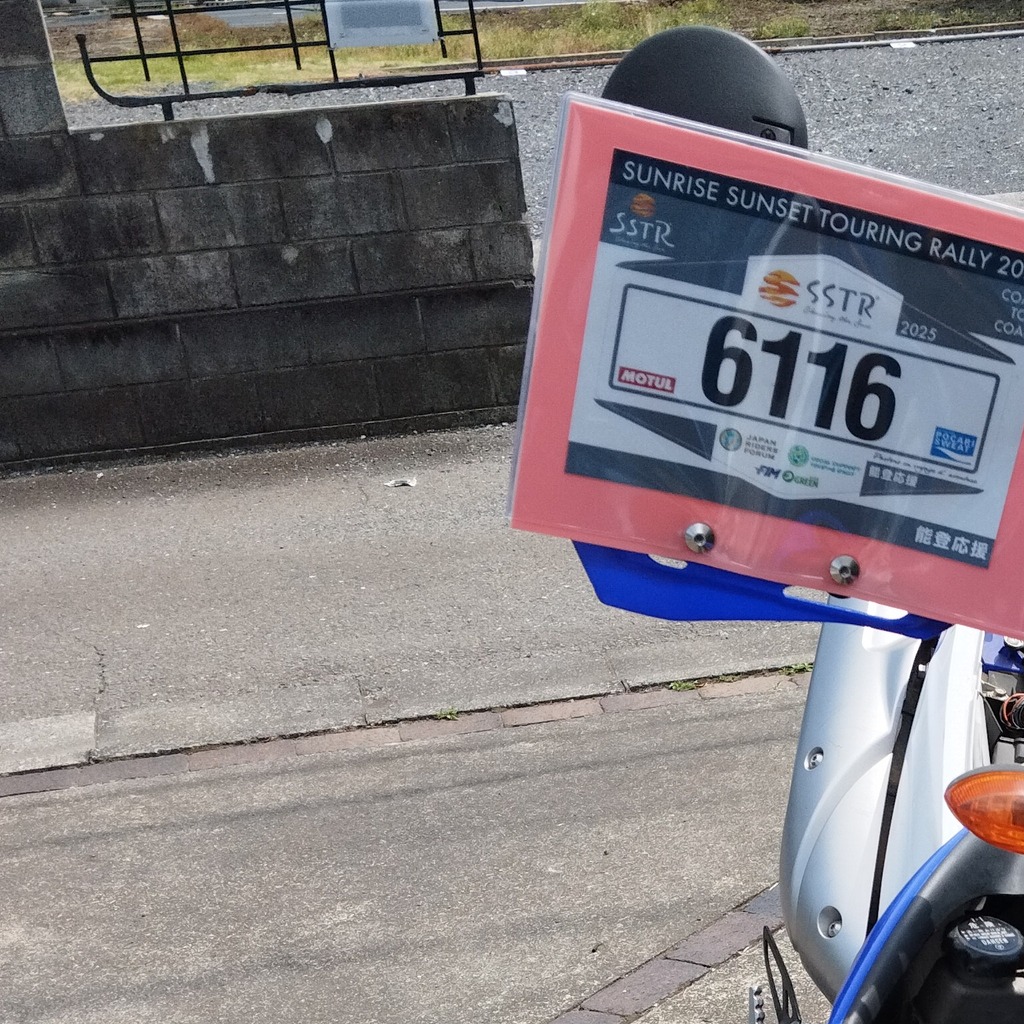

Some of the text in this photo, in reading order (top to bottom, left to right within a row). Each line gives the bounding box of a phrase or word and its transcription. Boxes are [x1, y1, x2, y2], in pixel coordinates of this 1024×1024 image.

[622, 161, 720, 202] SUNRISE
[726, 186, 813, 224] SUNSET
[818, 207, 922, 252] TOURING
[929, 237, 993, 270] RALLY
[609, 212, 675, 247] SSTR
[806, 279, 877, 319] SSTR
[900, 321, 937, 342] 2025
[619, 369, 674, 391] MOTUL
[701, 315, 902, 441] 6116
[746, 435, 777, 447] JAPAN
[934, 437, 970, 453] SWEAT
[935, 431, 976, 447] POCARI
[744, 447, 775, 460] FORUM
[914, 525, 989, 560] 能登応援
